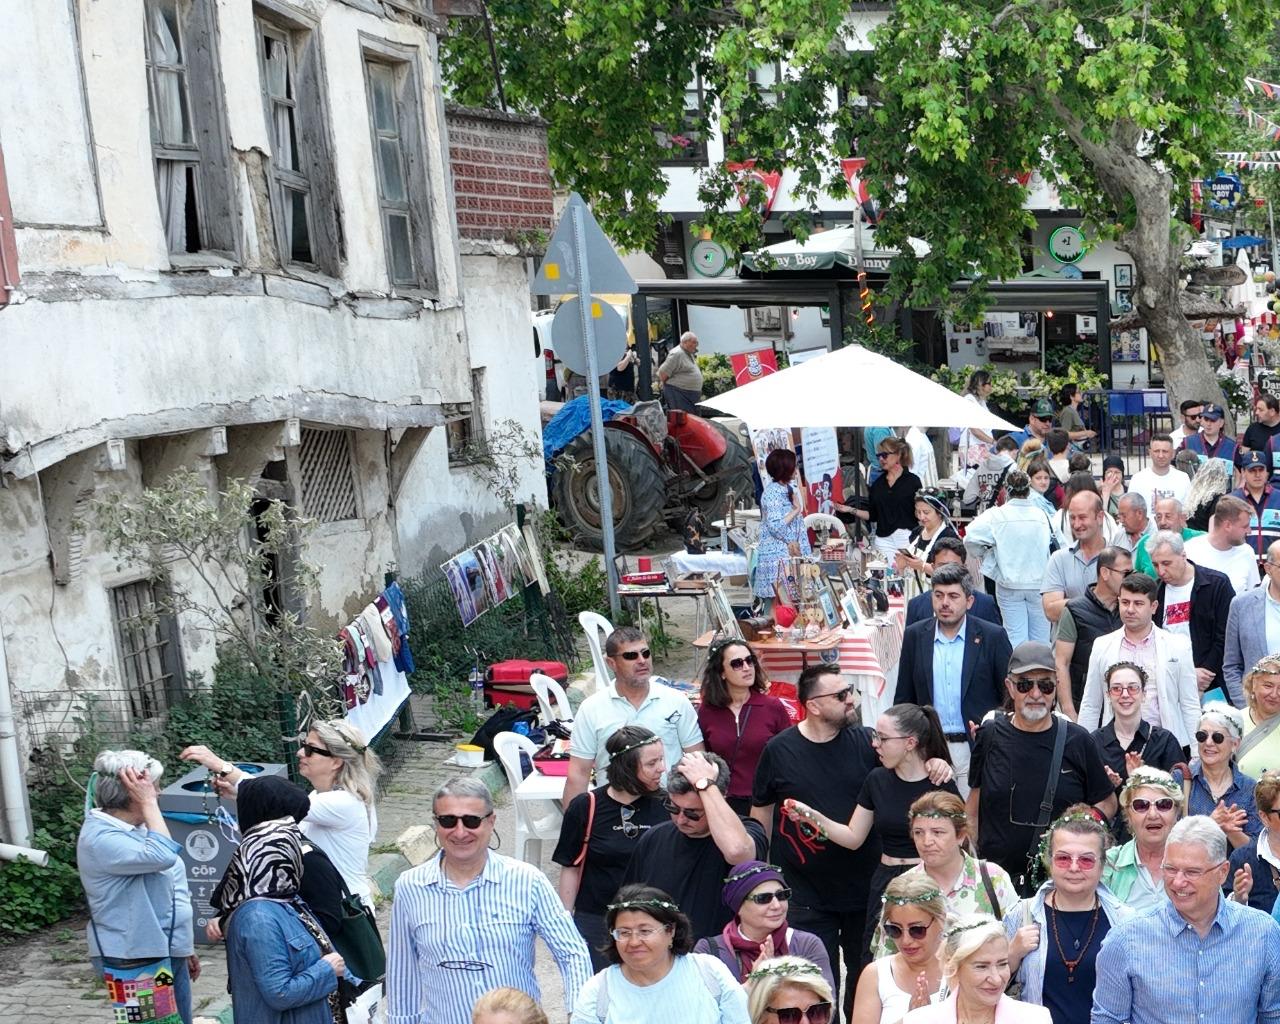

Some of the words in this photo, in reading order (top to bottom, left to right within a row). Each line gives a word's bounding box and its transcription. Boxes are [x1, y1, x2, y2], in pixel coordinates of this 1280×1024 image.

[794, 253, 818, 266] Boy
[847, 255, 891, 271] Dnny
[191, 864, 217, 878] ÇÖP
